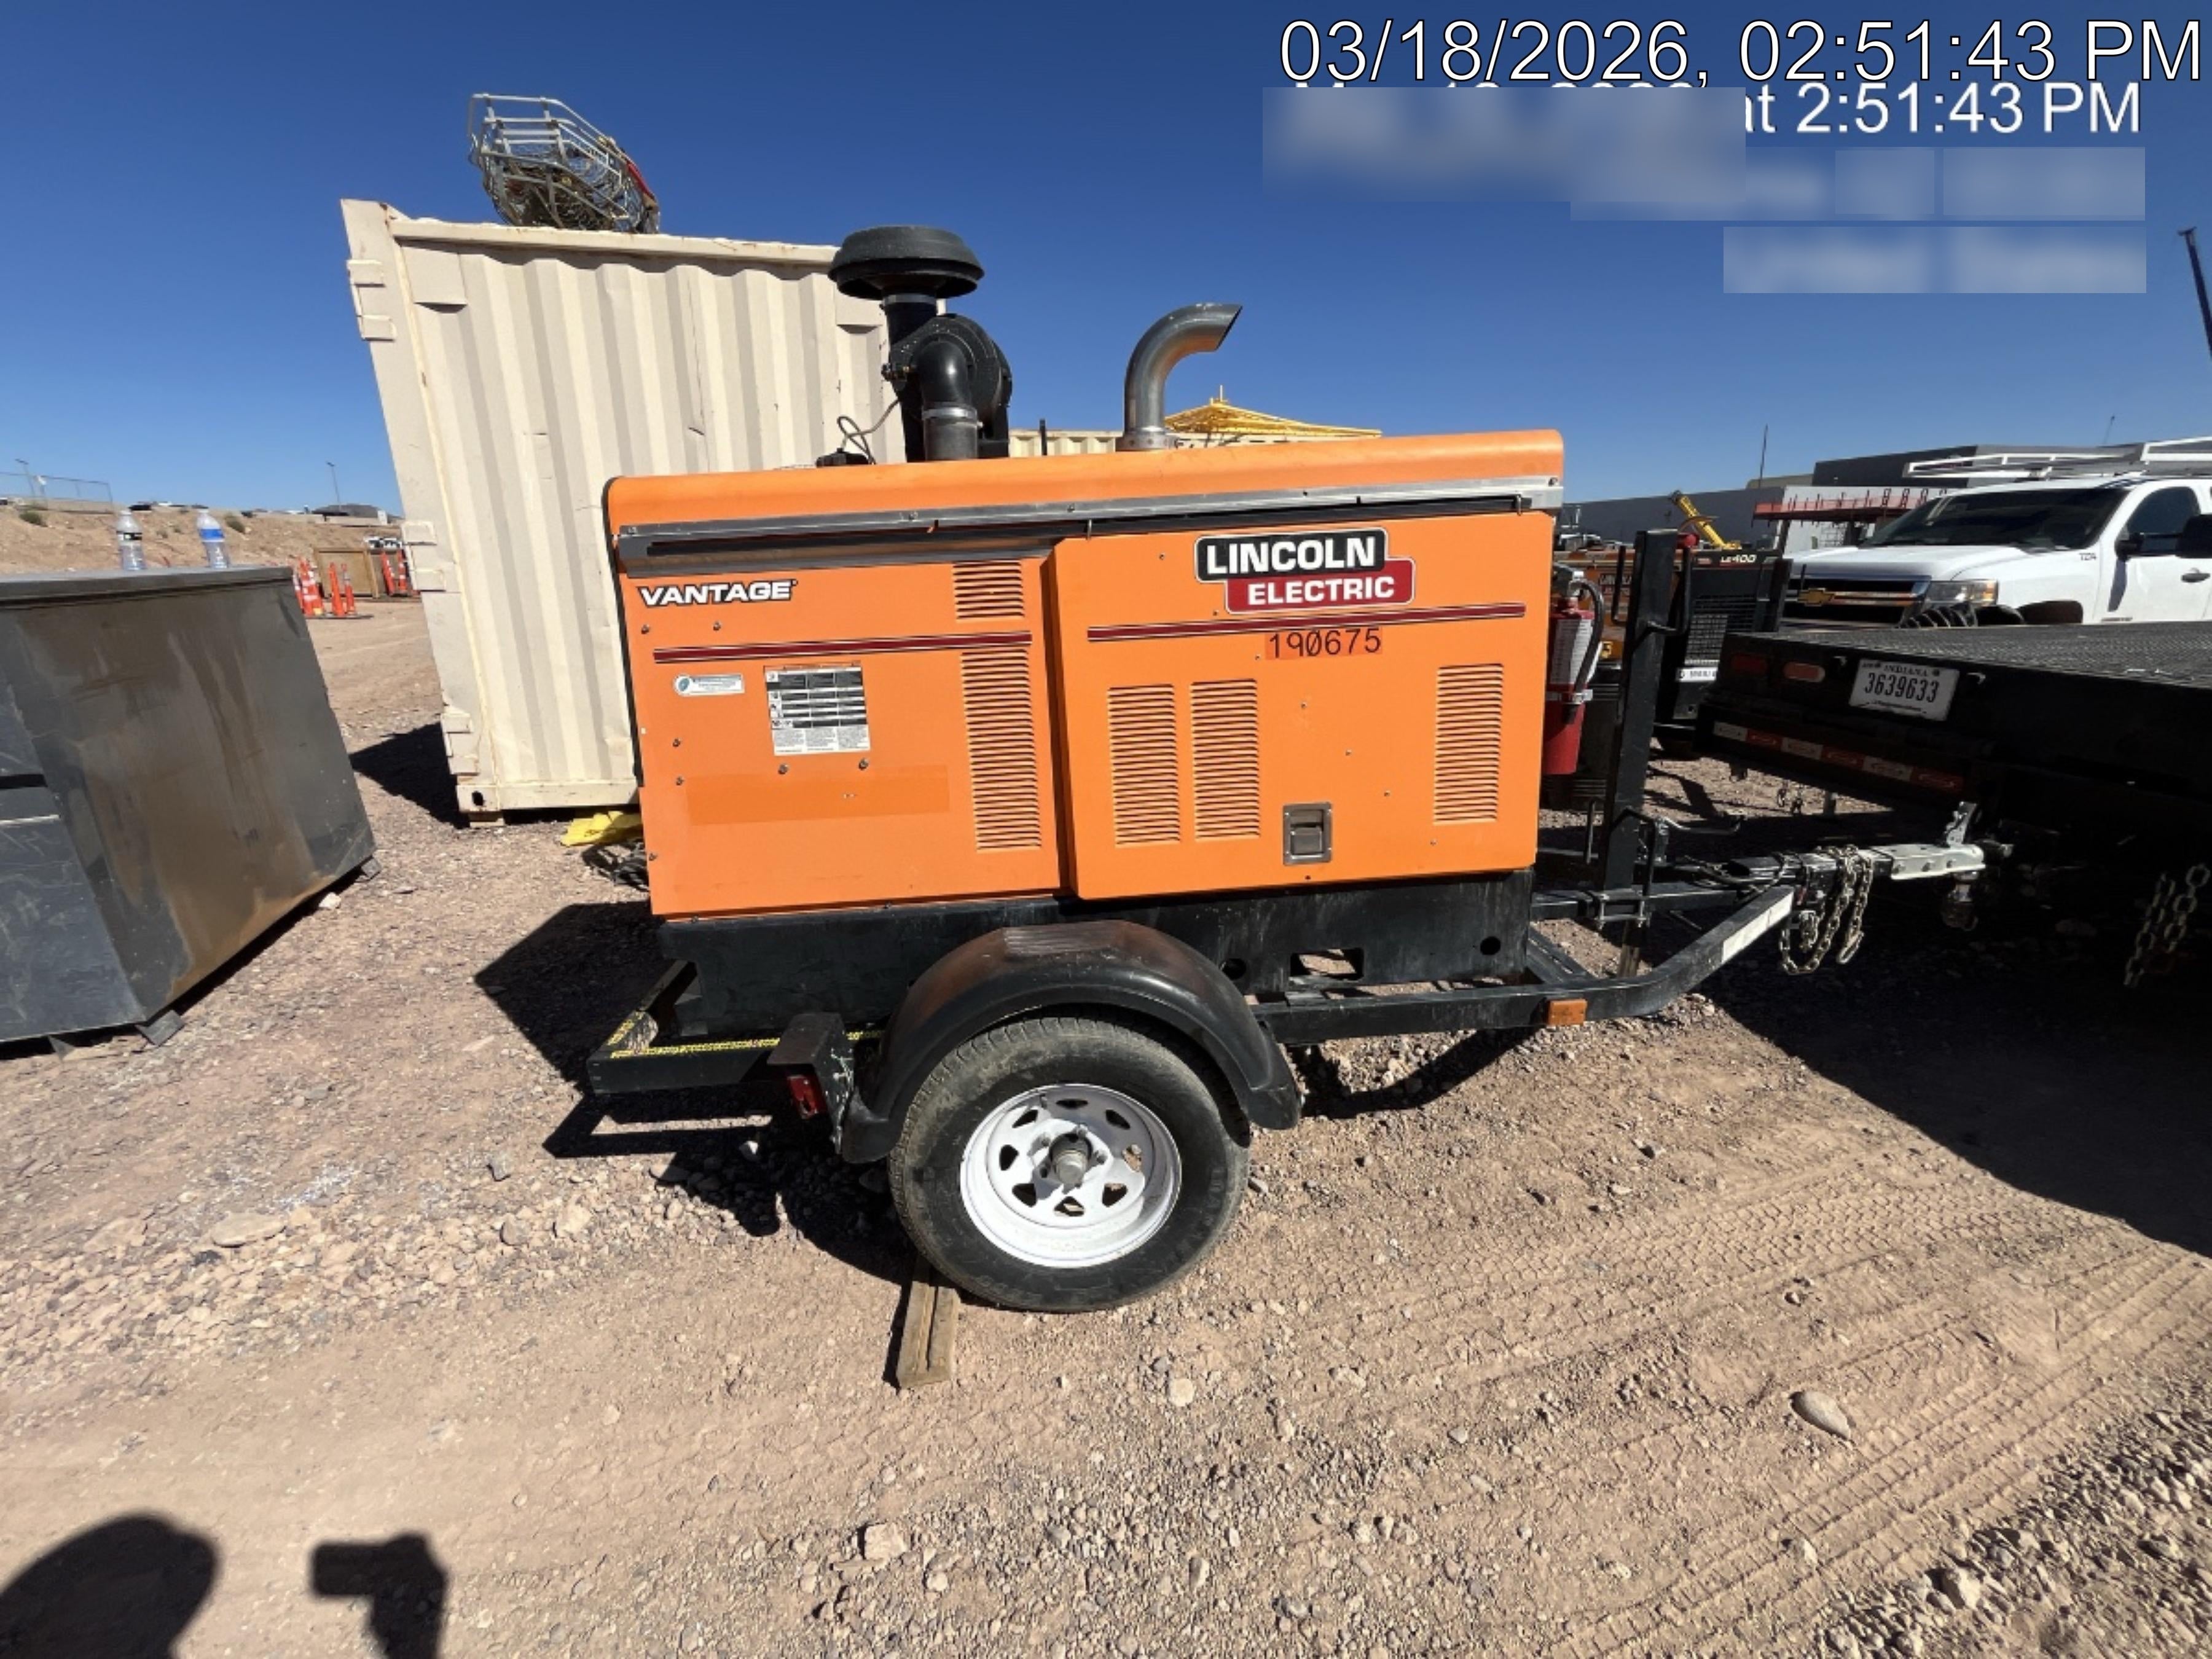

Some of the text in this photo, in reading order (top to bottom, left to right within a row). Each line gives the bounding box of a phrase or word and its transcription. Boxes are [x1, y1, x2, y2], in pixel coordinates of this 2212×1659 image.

[1207, 536, 1376, 575] LINCOLN
[639, 580, 792, 606] VANTAGE
[1248, 576, 1395, 605] ELECTRIC
[1269, 627, 1381, 659] 190675
[1883, 664, 1928, 677] INDIANA
[1865, 672, 1940, 703] 3639633
